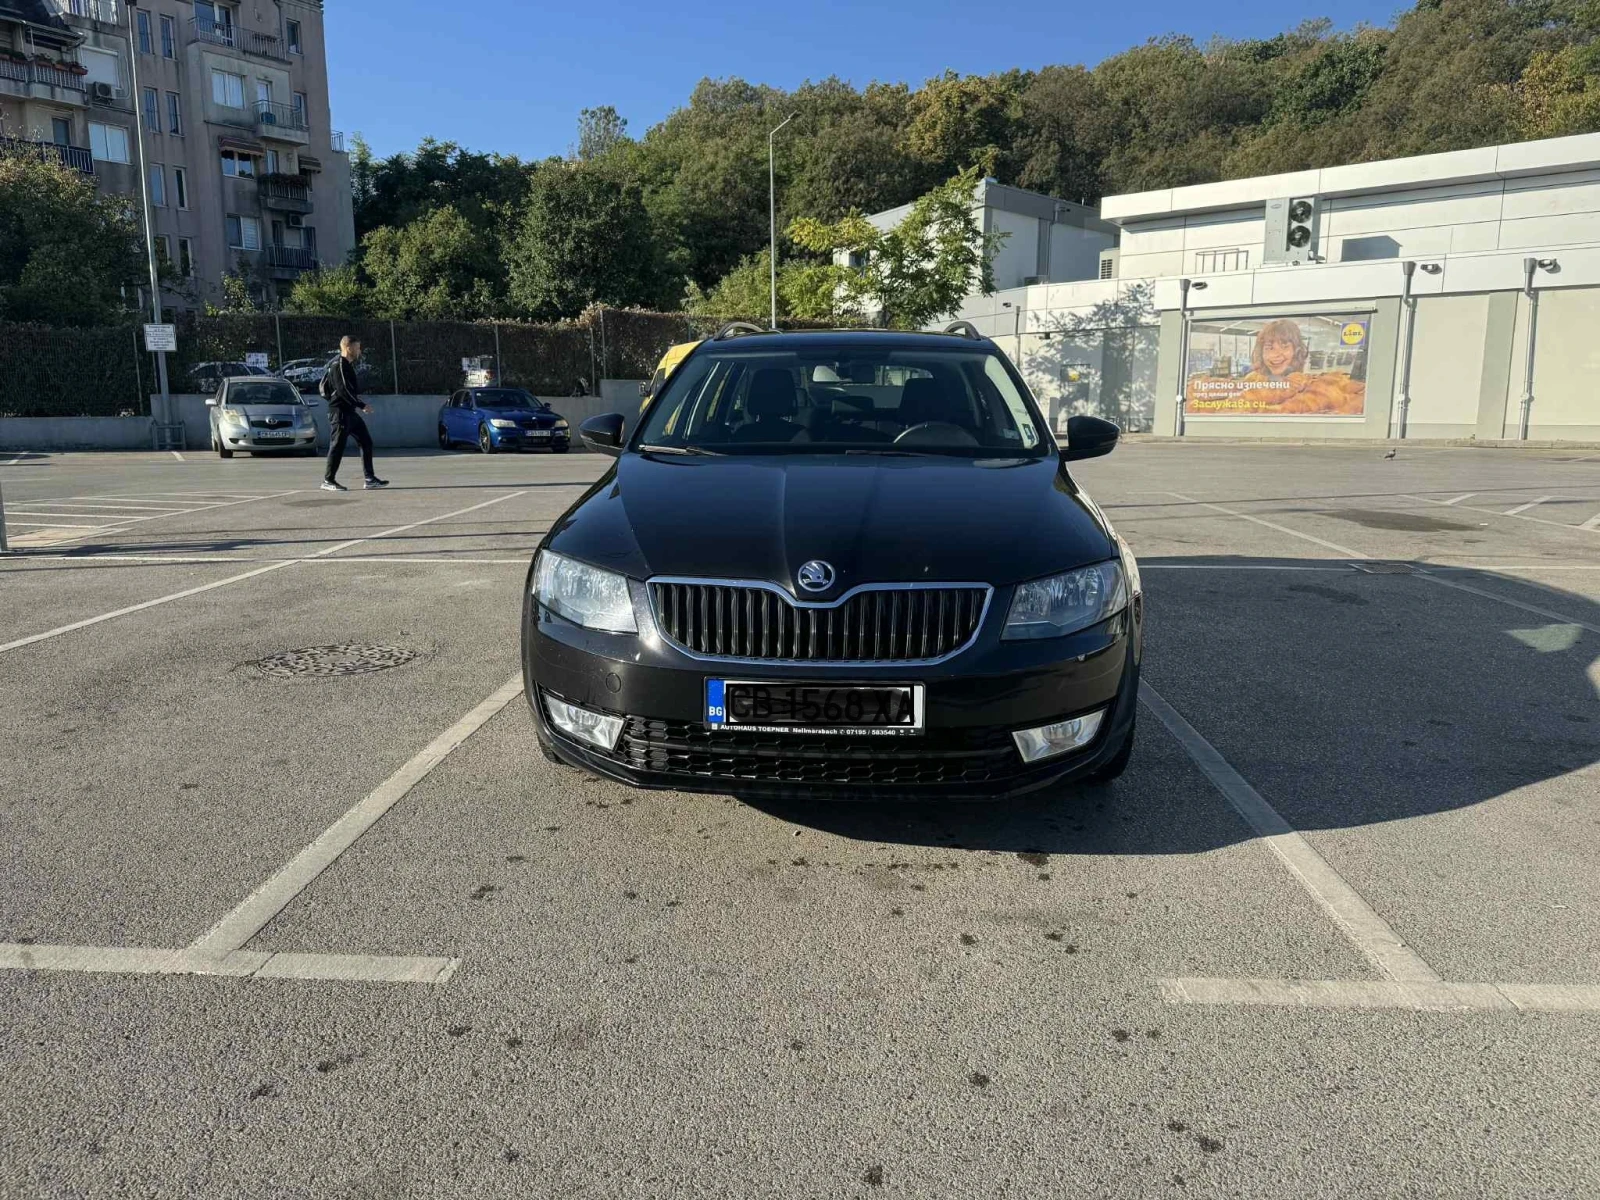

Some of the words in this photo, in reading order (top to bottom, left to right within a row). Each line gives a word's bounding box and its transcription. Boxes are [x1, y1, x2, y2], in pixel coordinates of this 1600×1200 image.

[1194, 380, 1234, 390] Прясно
[1237, 381, 1290, 390] изпечени
[1193, 399, 1250, 410] Заслужава
[709, 706, 722, 717] BG
[720, 724, 757, 732] AUTOHAUS
